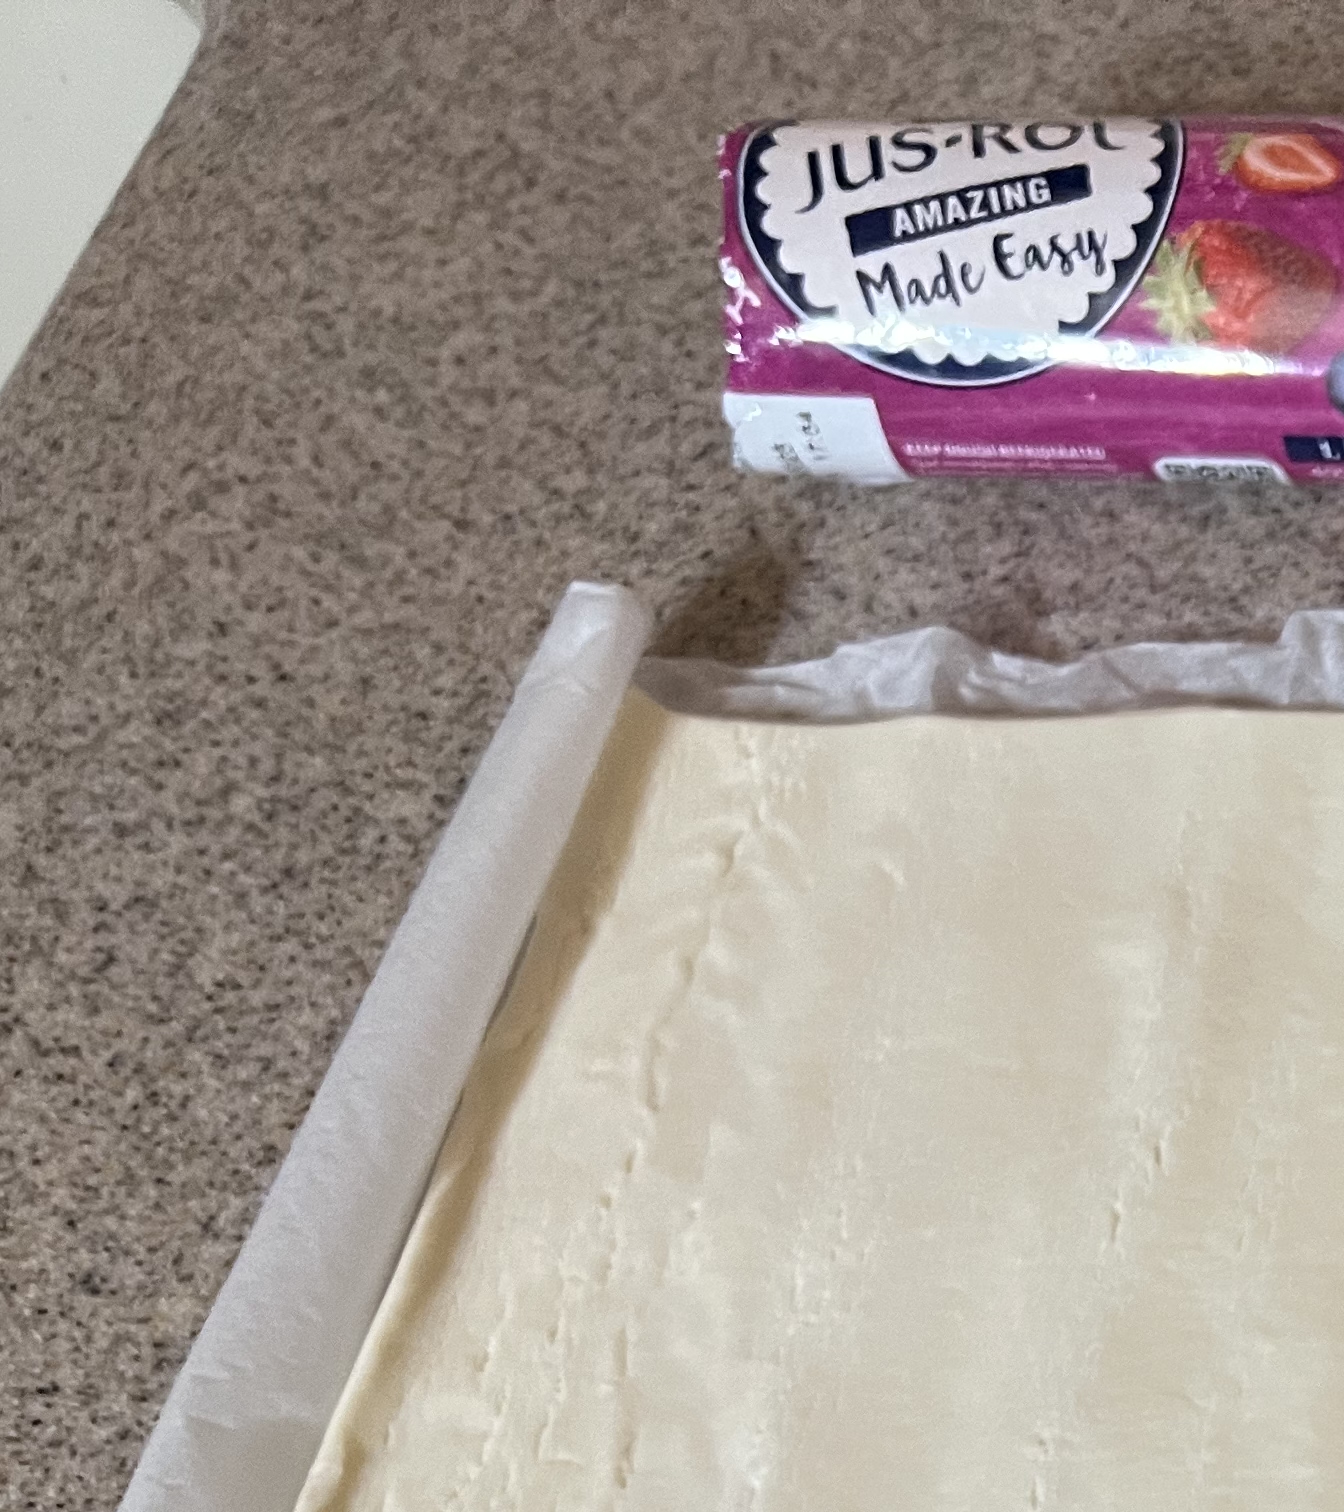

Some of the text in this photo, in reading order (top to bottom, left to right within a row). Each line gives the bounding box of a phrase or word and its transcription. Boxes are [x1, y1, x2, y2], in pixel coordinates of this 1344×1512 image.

[795, 120, 1126, 214] JUS-ROL
[892, 176, 1052, 238] AMAZING
[856, 227, 1108, 317] Made Easy
[1318, 440, 1341, 461] 1.
